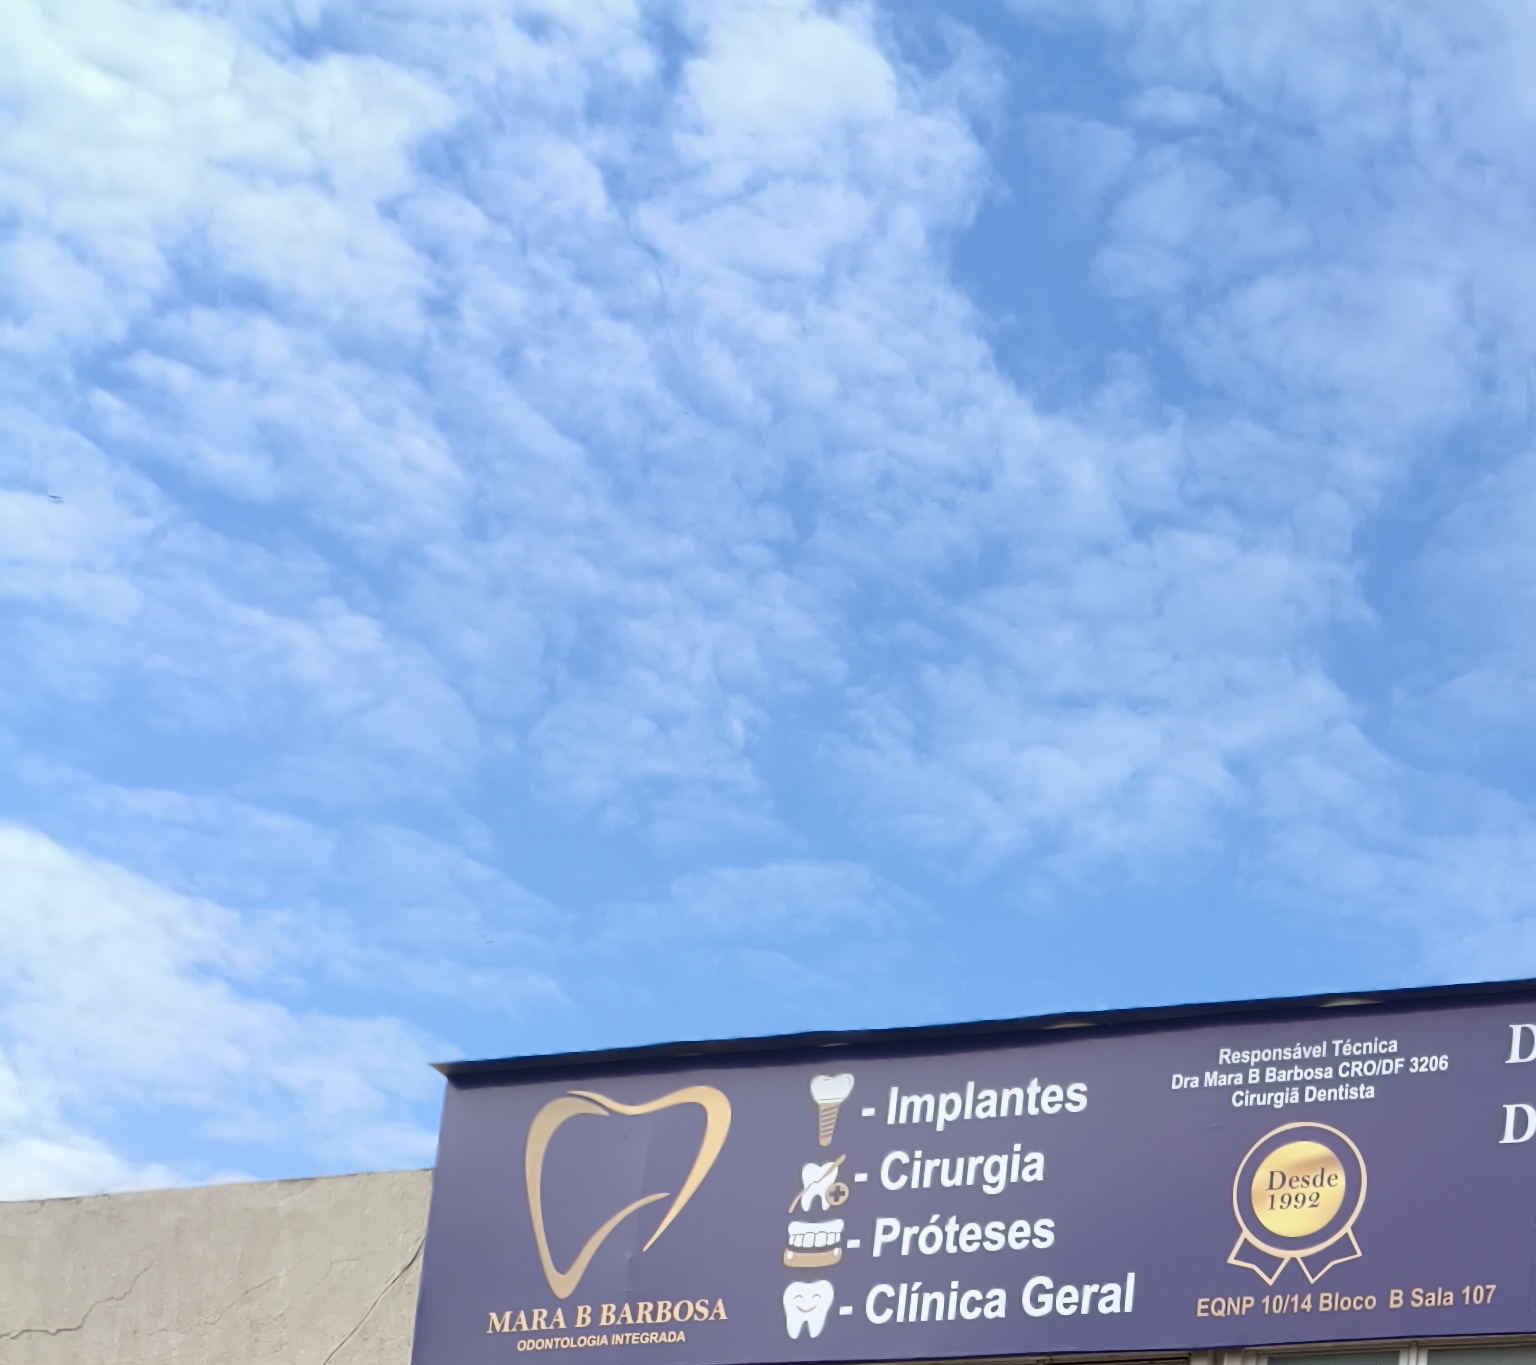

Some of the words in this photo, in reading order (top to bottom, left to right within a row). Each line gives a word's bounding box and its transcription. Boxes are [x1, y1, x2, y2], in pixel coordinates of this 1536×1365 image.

[1218, 1041, 1327, 1066] Responsável
[1332, 1037, 1398, 1057] Técnica
[1171, 1073, 1200, 1090] Dra
[1203, 1069, 1243, 1088] Mara
[1247, 1068, 1261, 1084] B
[1264, 1062, 1333, 1083] Barbosa
[1338, 1058, 1405, 1080] CRO/DF
[1408, 1054, 1449, 1074] 3206
[886, 1077, 1089, 1132] Implantes
[1231, 1087, 1300, 1109] Cirurgiã
[1304, 1083, 1375, 1103] Dentista
[880, 1144, 1046, 1195] Cirurgia
[1265, 1167, 1339, 1191] Desde
[1266, 1191, 1321, 1211] 1992
[872, 1214, 1056, 1258] Próteses
[865, 1280, 1007, 1325] Clínica
[1021, 1272, 1136, 1317] Geral
[1195, 1296, 1255, 1317] EQNP
[1261, 1292, 1313, 1315] 10/14
[1318, 1290, 1377, 1312] Bloco
[1389, 1289, 1405, 1309] B
[1410, 1287, 1454, 1307] Sala
[1461, 1284, 1497, 1305] 107
[486, 1307, 566, 1334] MARA
[574, 1305, 592, 1329] B
[599, 1298, 728, 1327] BARBOSA
[516, 1333, 608, 1352] ODONTOLOGIA
[611, 1331, 686, 1347] INTEGRADA
